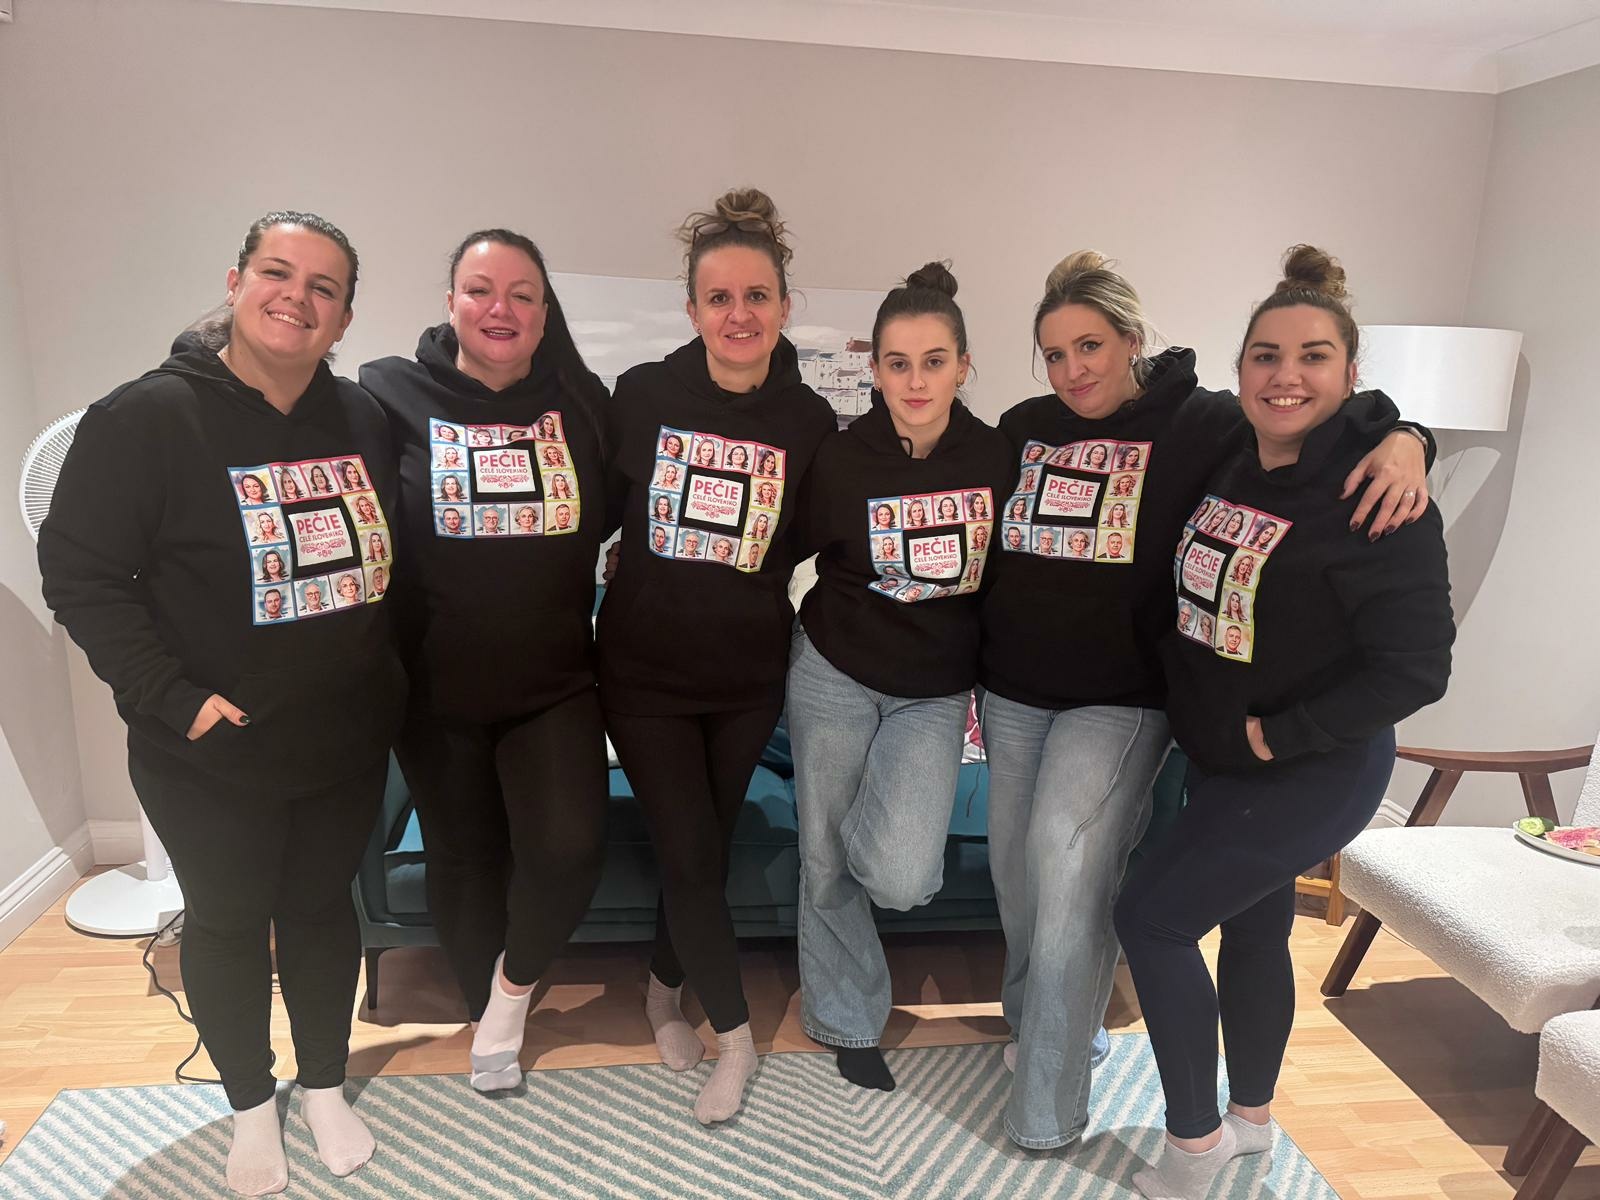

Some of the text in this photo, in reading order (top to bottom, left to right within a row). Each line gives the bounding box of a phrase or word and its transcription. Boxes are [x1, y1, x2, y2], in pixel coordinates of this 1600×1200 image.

[479, 450, 526, 467] PEČIE
[694, 479, 738, 500] PEČIE
[1048, 479, 1094, 496] PEČIE
[296, 512, 341, 535] PEČIE
[913, 537, 956, 557] PEČIE
